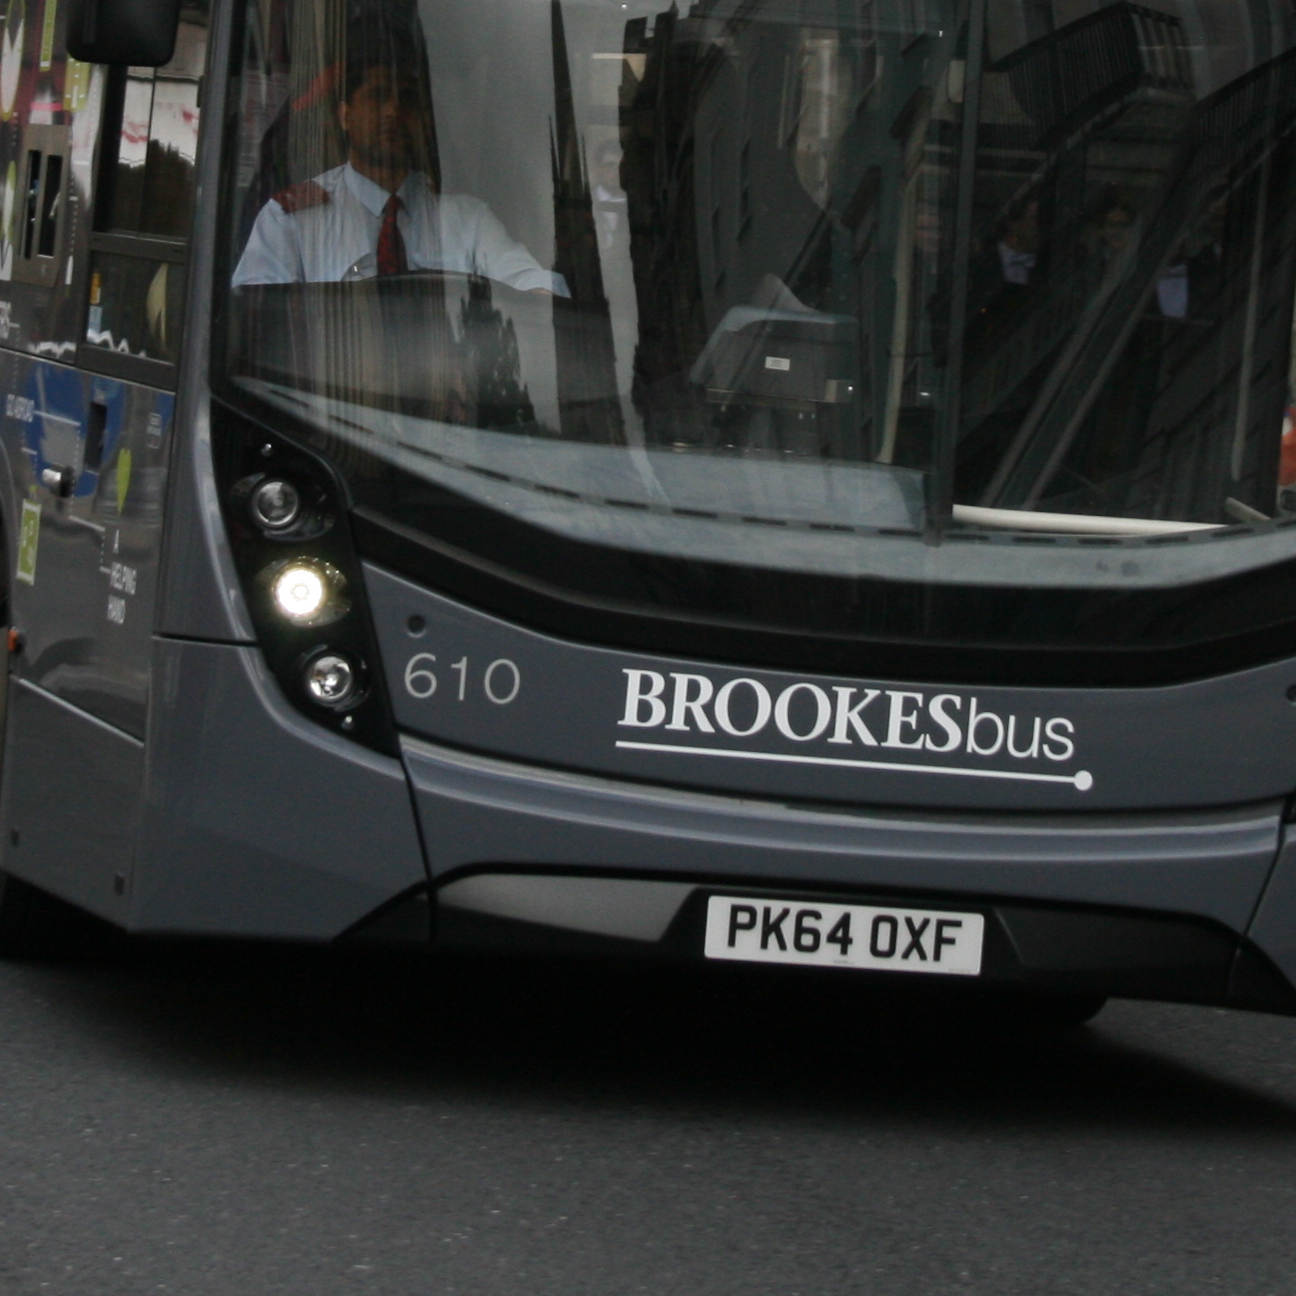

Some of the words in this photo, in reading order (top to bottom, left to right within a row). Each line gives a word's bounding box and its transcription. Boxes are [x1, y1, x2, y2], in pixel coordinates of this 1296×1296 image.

[404, 652, 521, 705] 610
[616, 667, 1076, 762] BROOKESbus
[727, 903, 854, 957] PK64
[869, 914, 964, 963] OXF
